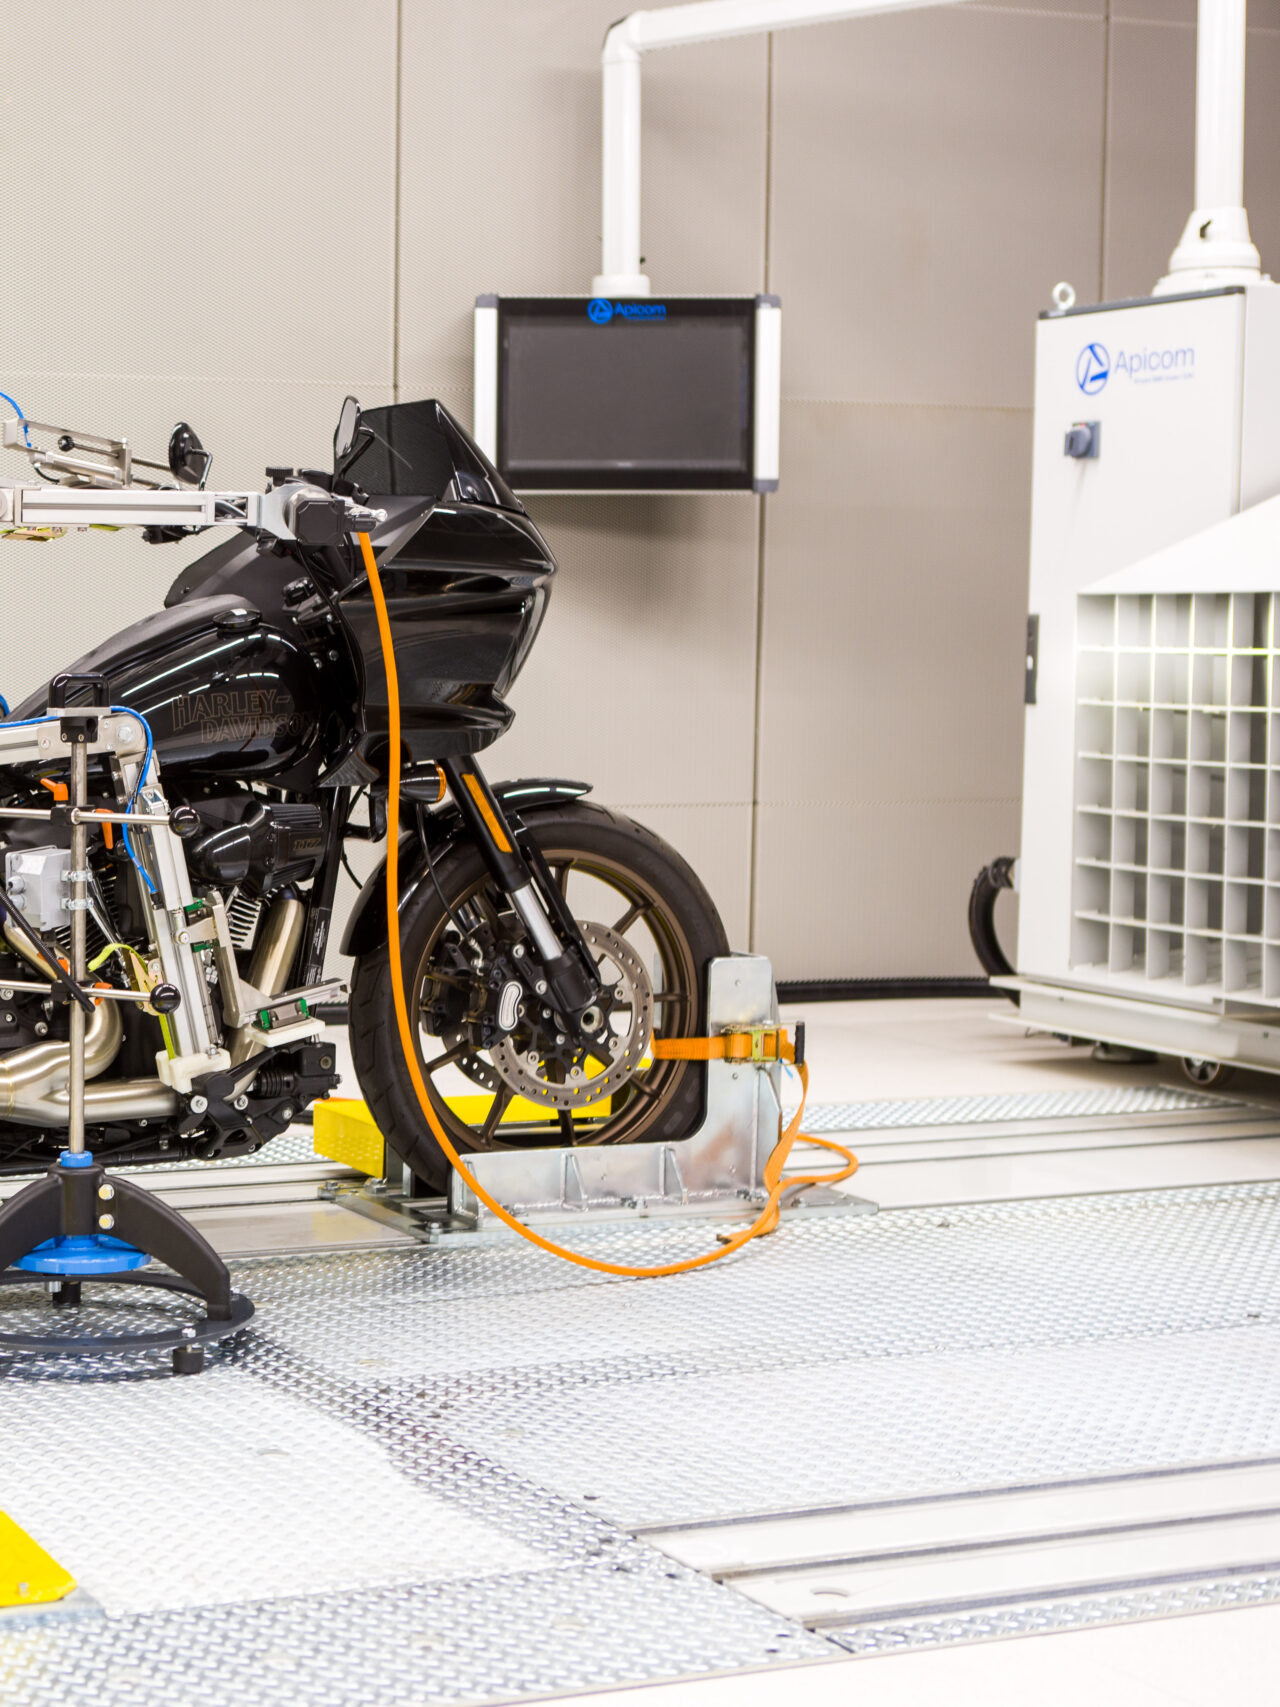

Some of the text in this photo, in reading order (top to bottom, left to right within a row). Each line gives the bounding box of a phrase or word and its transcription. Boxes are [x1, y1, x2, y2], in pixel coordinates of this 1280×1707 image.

[1114, 348, 1195, 377] Apicom
[171, 689, 290, 732] HARLEY-
[201, 712, 308, 743] DAVIDSO
